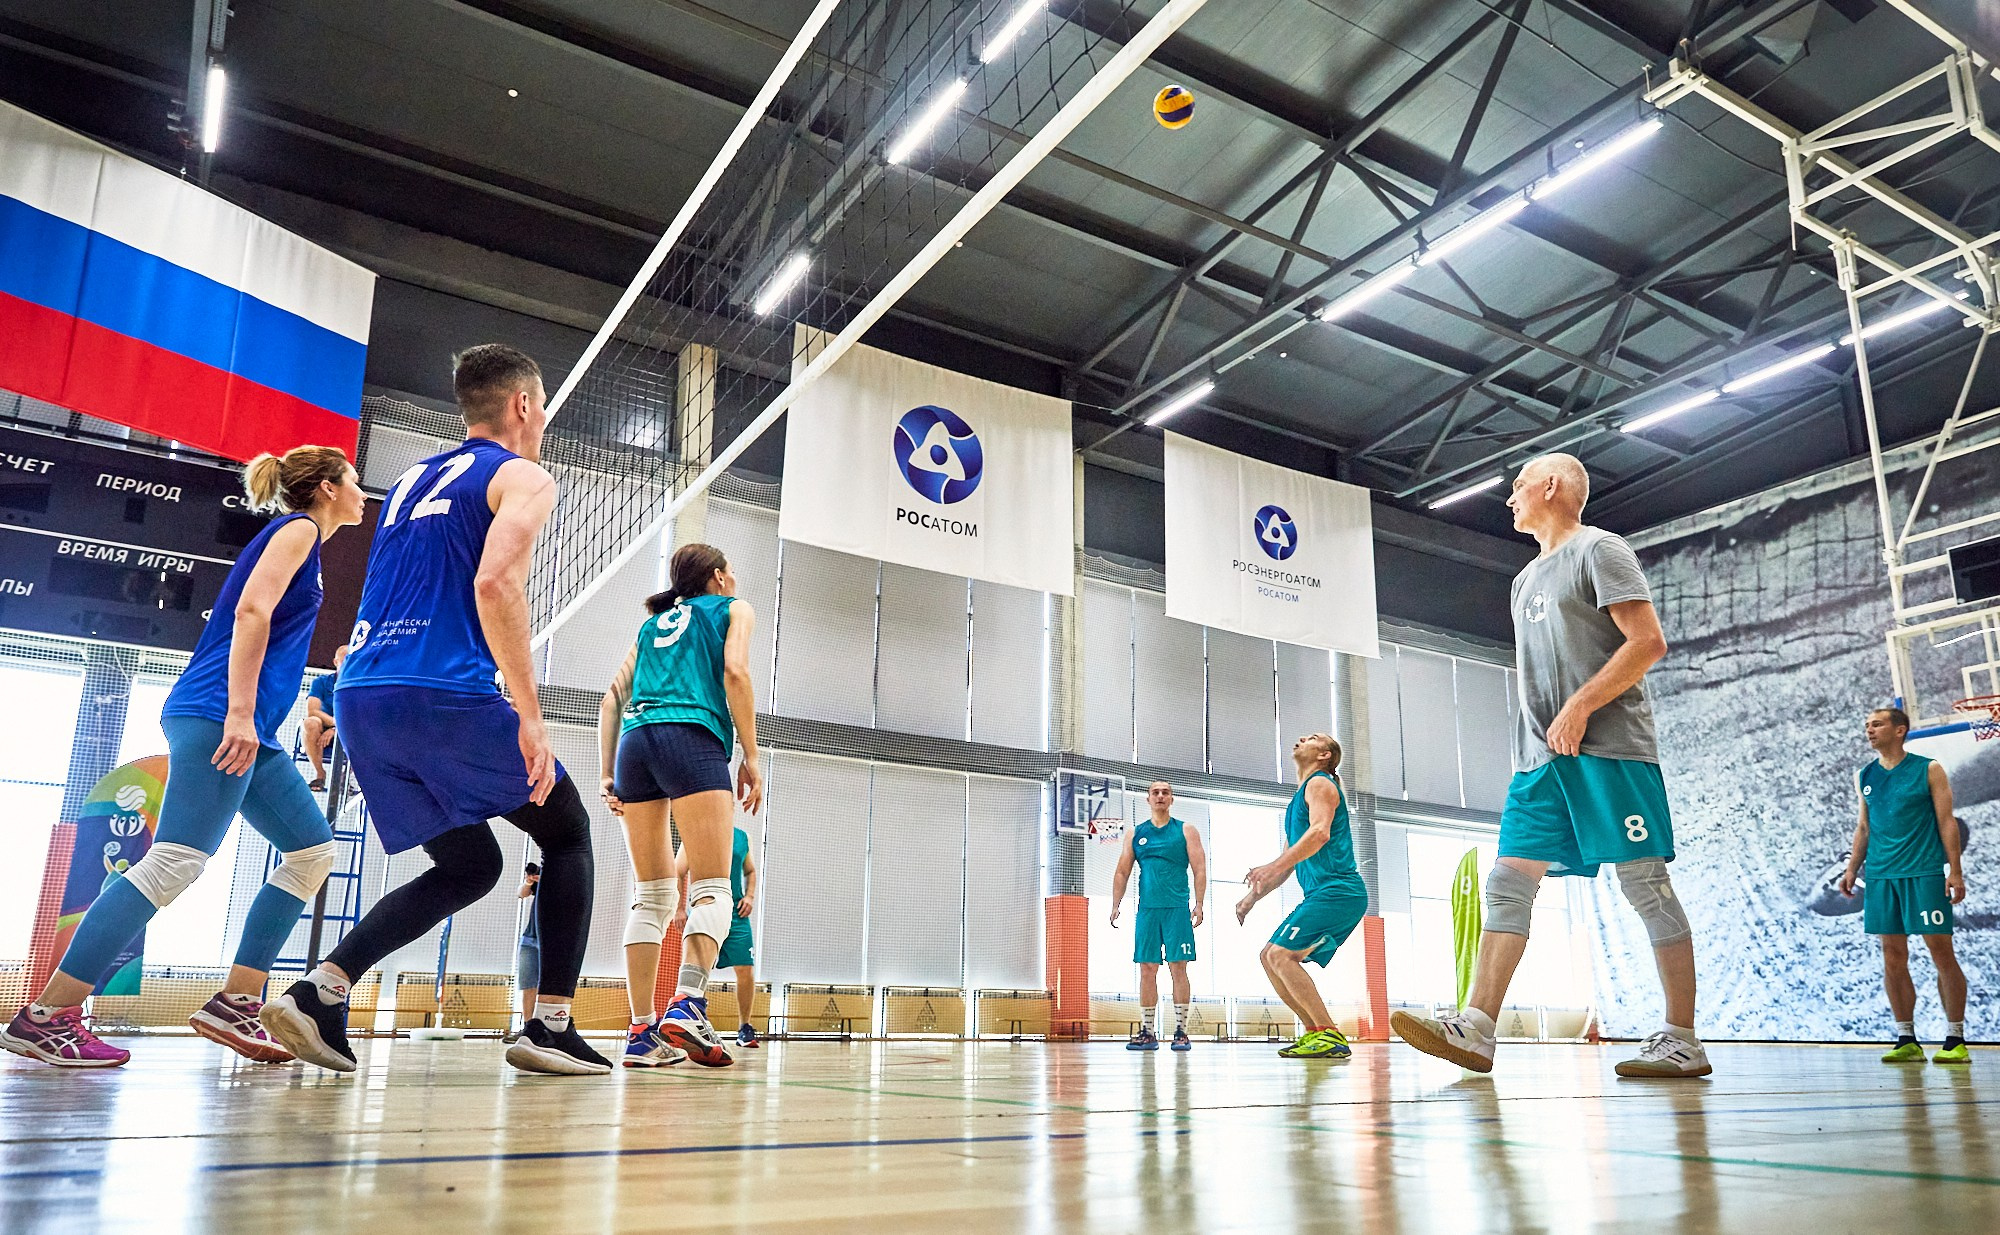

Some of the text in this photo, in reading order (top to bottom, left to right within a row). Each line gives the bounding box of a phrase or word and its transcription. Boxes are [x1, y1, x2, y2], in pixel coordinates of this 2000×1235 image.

[96, 473, 182, 503] ПЕРИОД
[383, 452, 476, 528] 12
[896, 507, 978, 538] РОСАТОМ
[57, 540, 195, 574] ВРЕМЯ ИГРЫ
[1232, 559, 1321, 588] РОСЭНЕРГОАТОМ
[1258, 586, 1299, 603] РОСАТОМ
[653, 603, 693, 648] 9
[1624, 814, 1649, 842] 8
[1919, 909, 1945, 926] 10
[1180, 942, 1192, 955] 12
